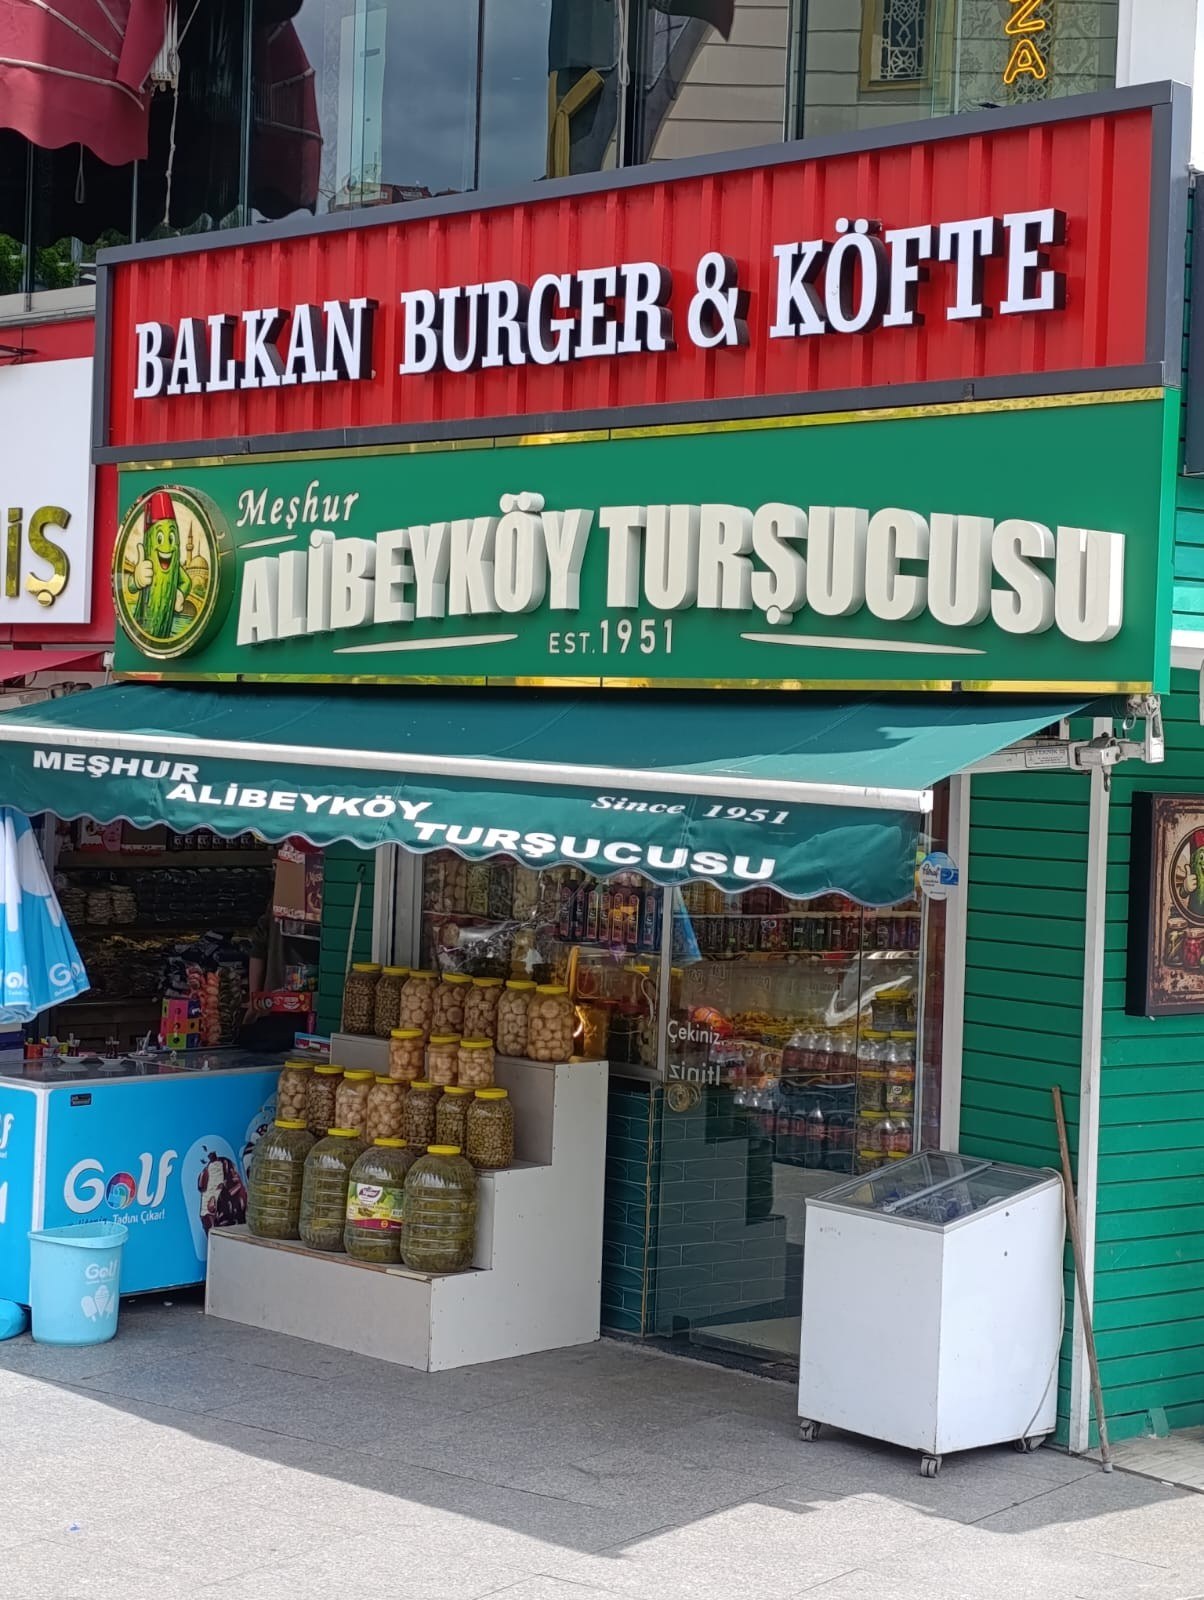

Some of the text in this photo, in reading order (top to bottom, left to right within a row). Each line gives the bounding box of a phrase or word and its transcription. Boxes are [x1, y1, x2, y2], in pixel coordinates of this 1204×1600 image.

[133, 207, 1064, 399] BALKAN BURGER & KÖFTE
[236, 479, 360, 530] Meşhur
[236, 491, 1126, 646] ALİBEYKÖY TURŞUCUSU
[600, 618, 674, 654] 1951
[32, 750, 200, 783] MEŞHUR
[165, 782, 433, 820] ALİBEYKÖY
[591, 795, 791, 825] Since 1951
[413, 821, 777, 881] TURŞUCUSU
[63, 1149, 179, 1214] Golf
